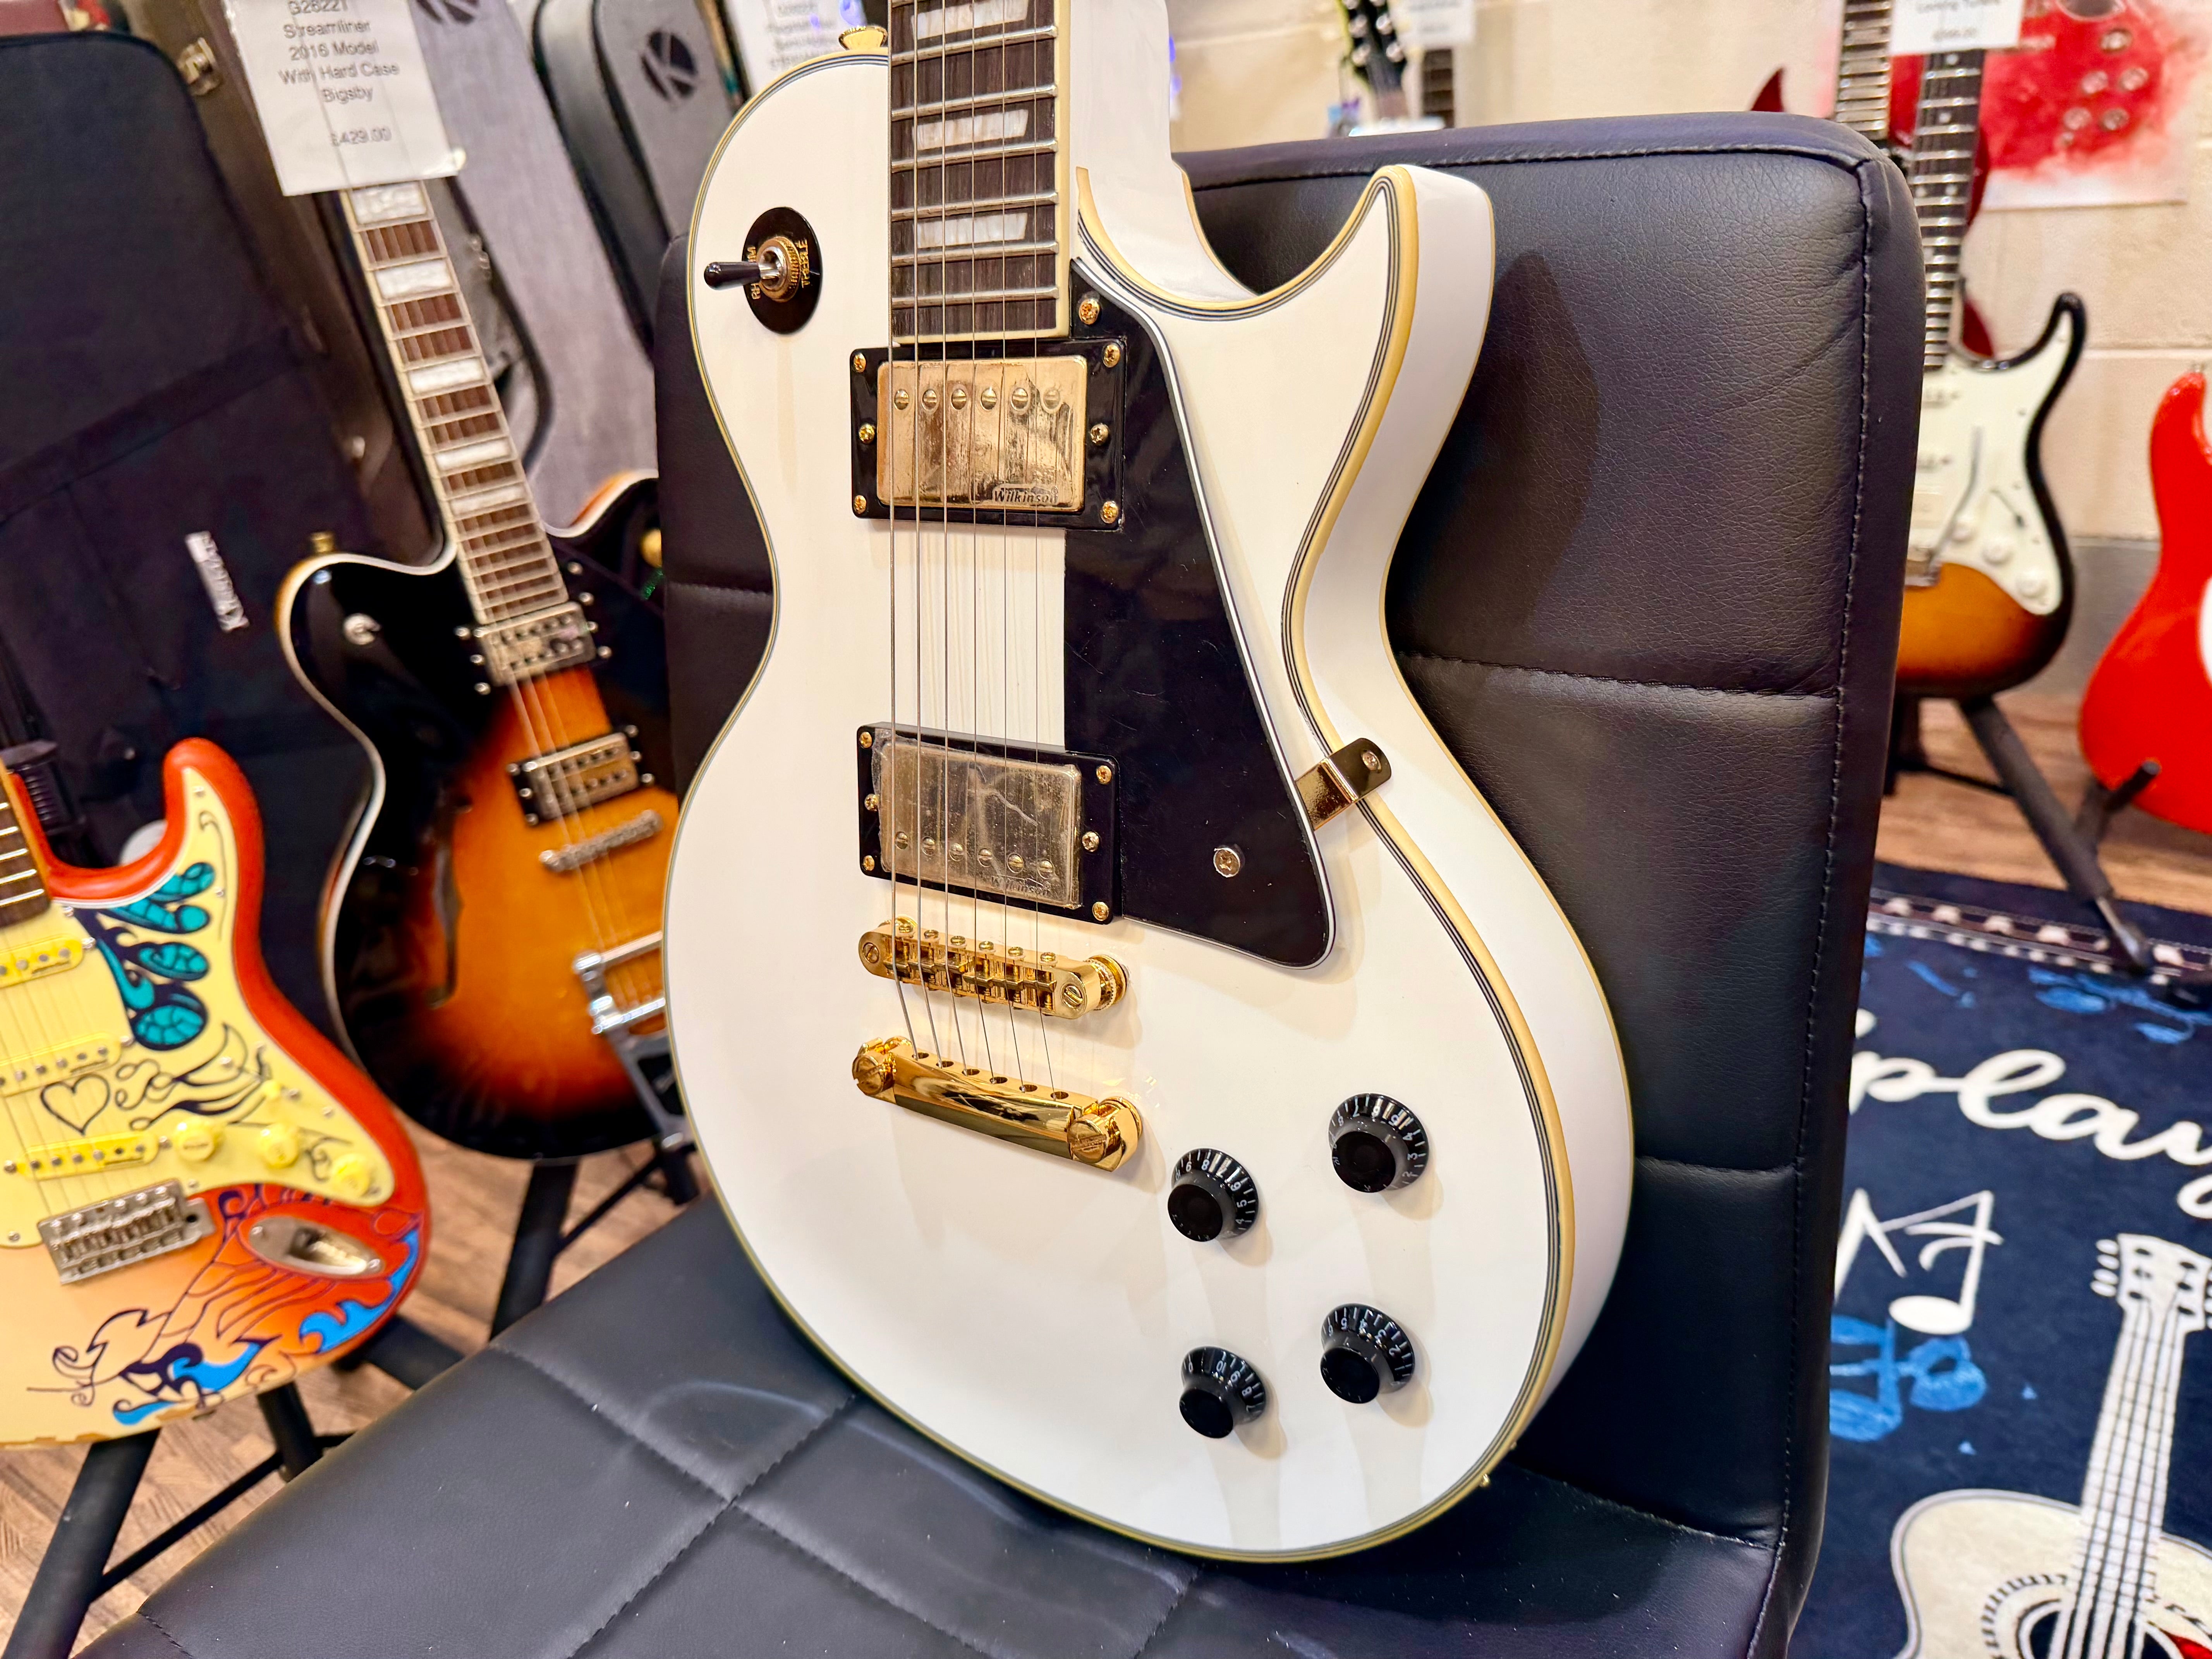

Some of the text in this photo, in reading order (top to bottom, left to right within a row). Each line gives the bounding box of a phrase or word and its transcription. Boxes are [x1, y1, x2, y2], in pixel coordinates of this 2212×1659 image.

[283, 19, 371, 38] Streamliner
[289, 38, 379, 60] 2016 Model
[278, 61, 400, 84] With Hard Case
[322, 86, 373, 104] Bigsby
[994, 489, 1058, 503] Wilkinson
